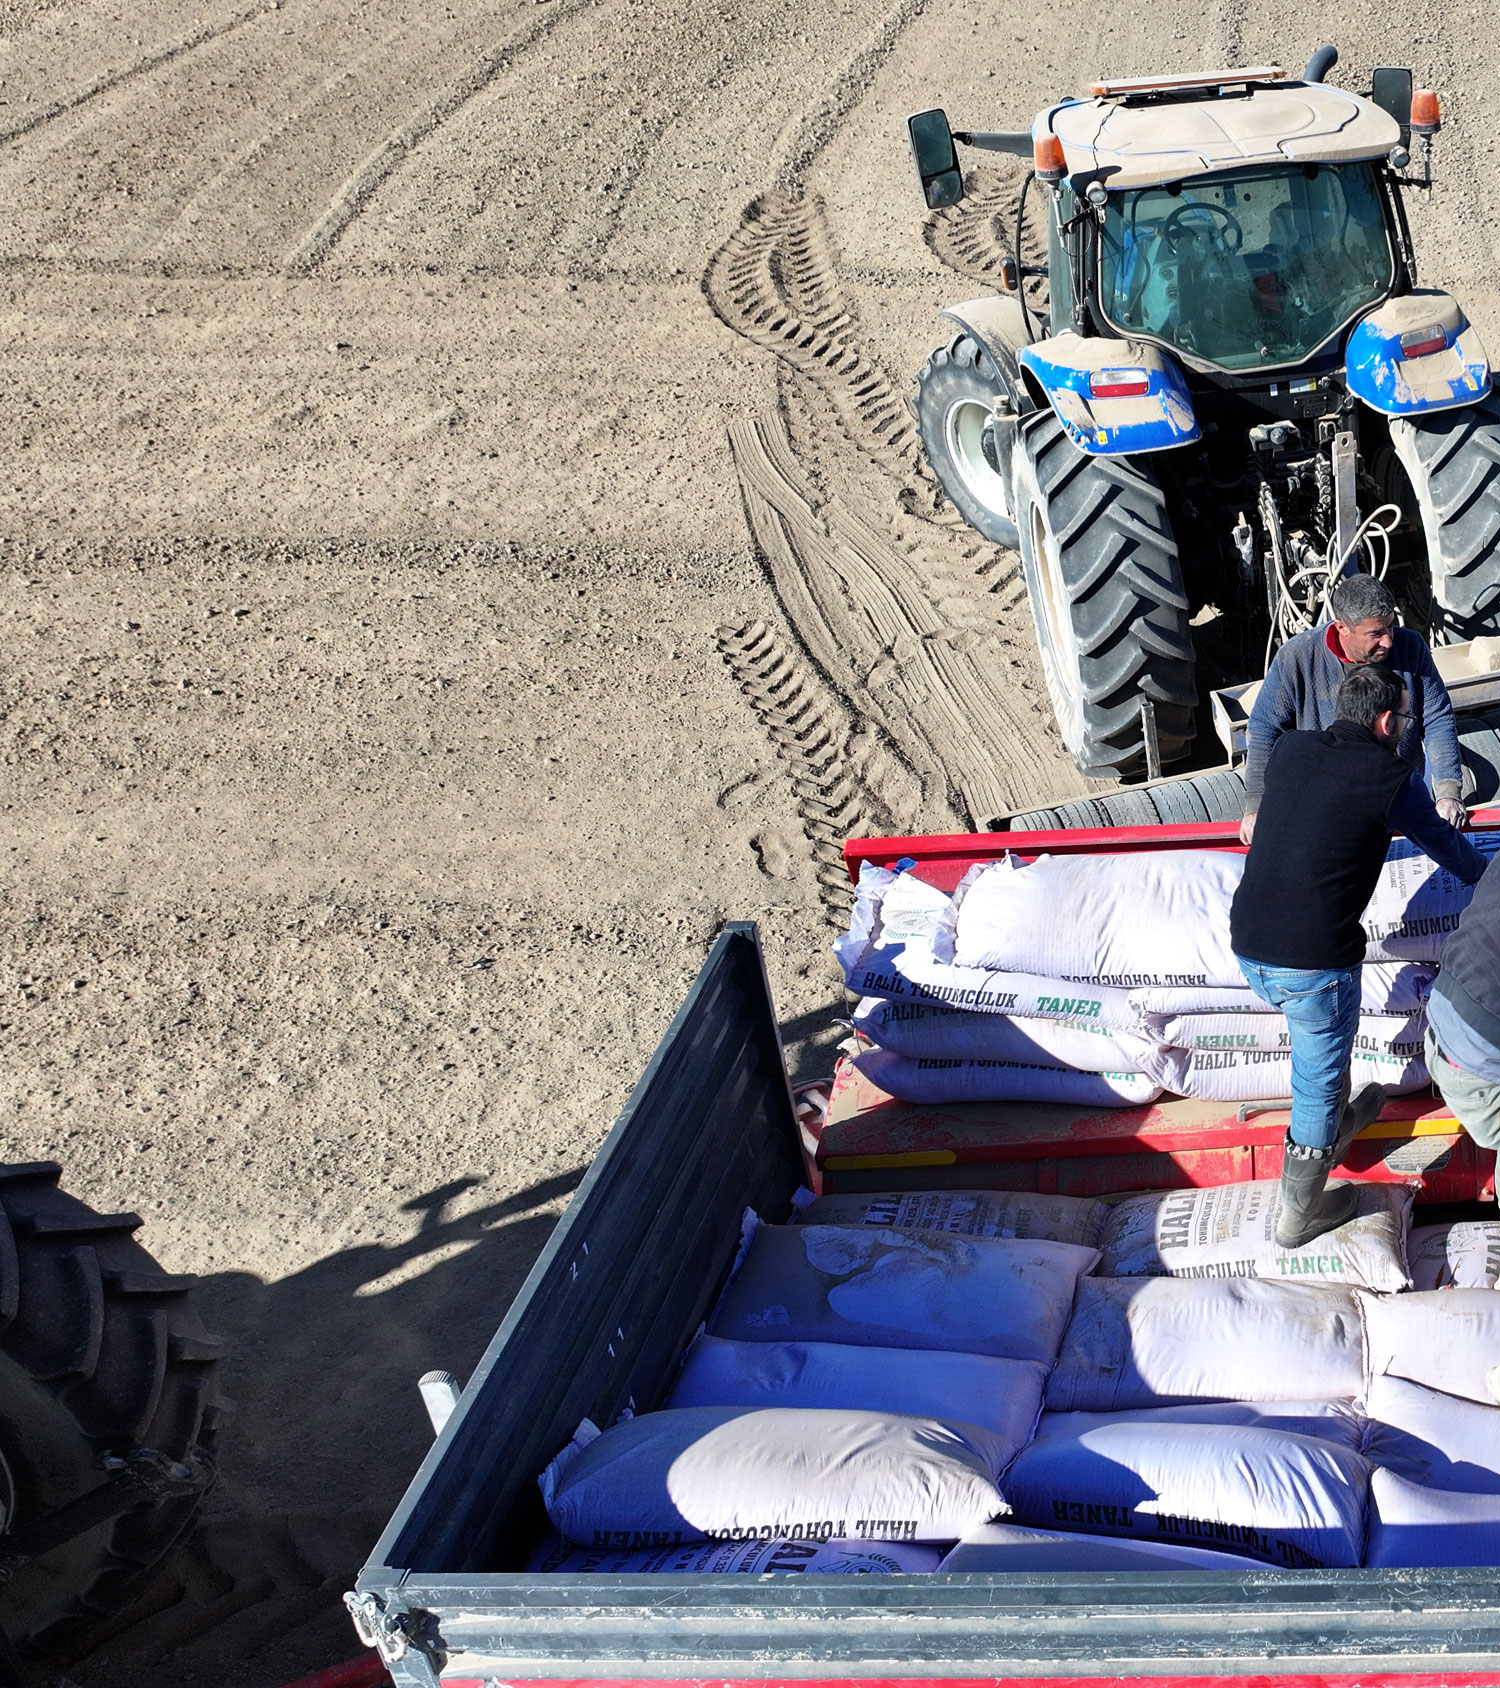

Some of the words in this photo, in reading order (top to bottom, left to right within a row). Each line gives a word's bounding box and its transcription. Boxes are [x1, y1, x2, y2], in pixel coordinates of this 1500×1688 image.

[1388, 912, 1461, 939] TOHUMCU
[911, 982, 1018, 1008] TOHUMCULUK
[1037, 996, 1102, 1017] TANER
[1275, 1255, 1345, 1275] TANER
